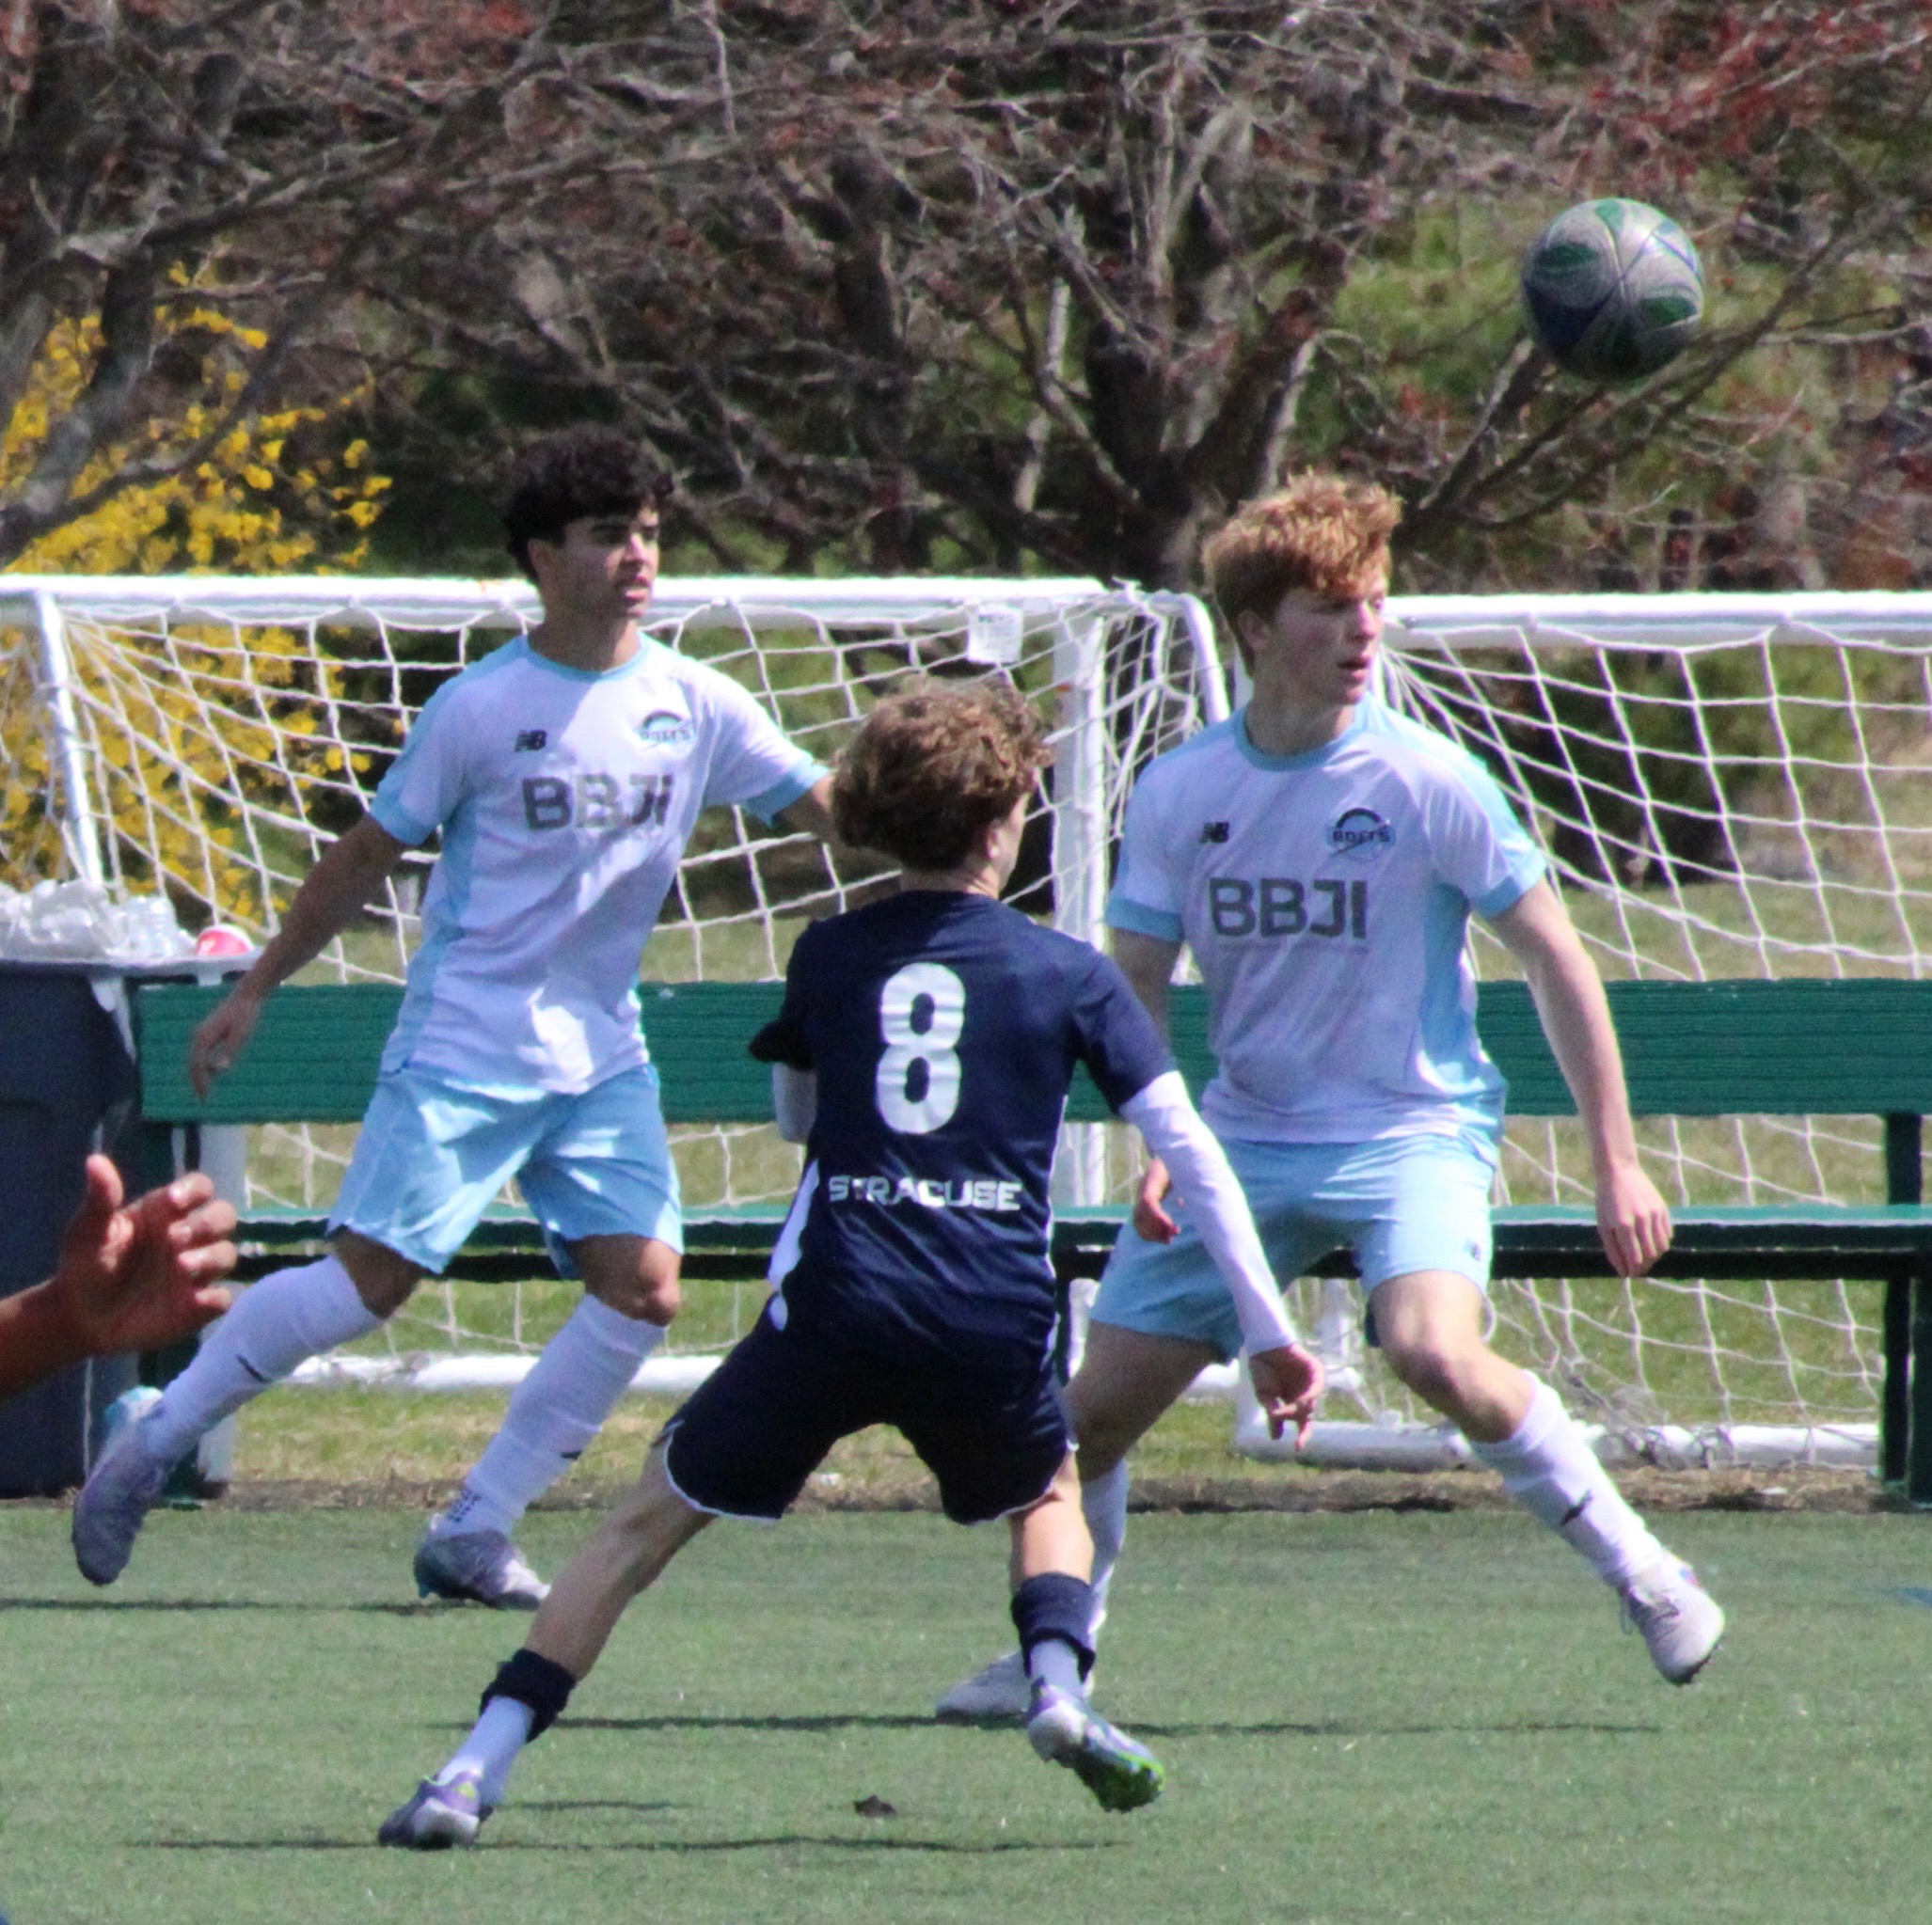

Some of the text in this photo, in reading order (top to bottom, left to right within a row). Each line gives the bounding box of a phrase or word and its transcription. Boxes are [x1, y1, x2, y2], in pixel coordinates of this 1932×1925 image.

[522, 773, 673, 831] BBJI
[1209, 876, 1369, 940] BBJI
[876, 961, 966, 1135] 8
[829, 1175, 1021, 1211] SYRACUSE
